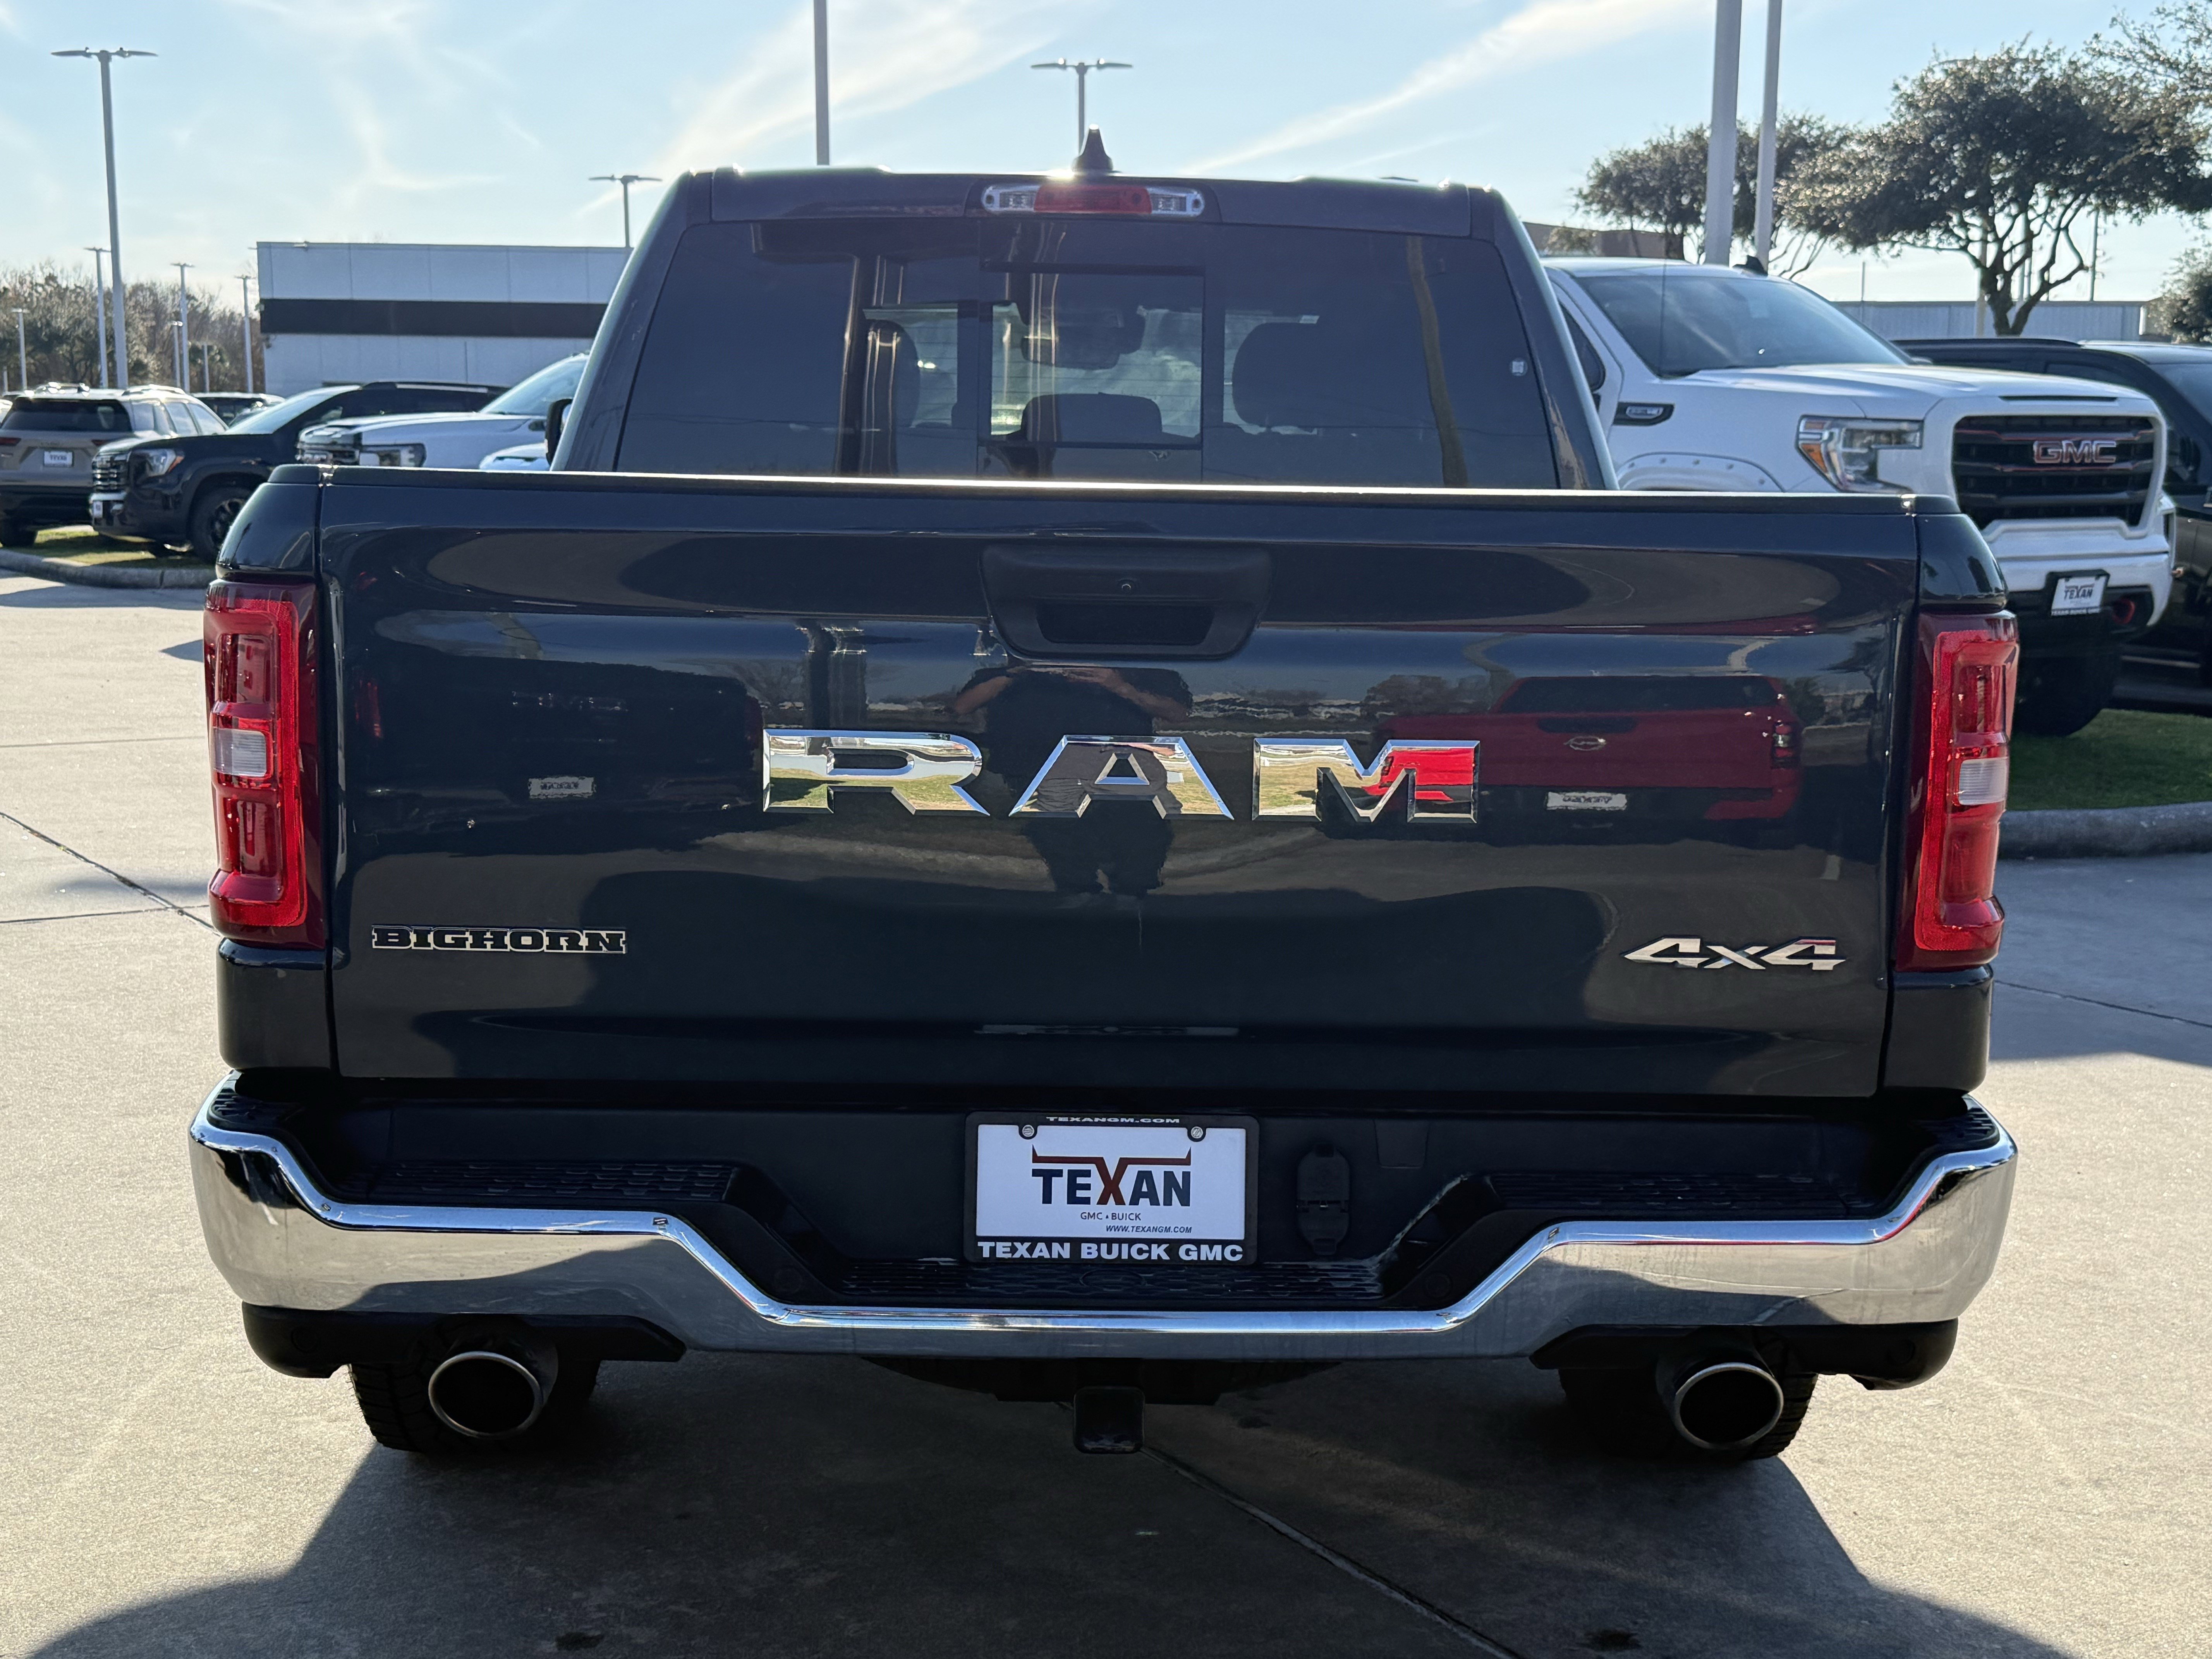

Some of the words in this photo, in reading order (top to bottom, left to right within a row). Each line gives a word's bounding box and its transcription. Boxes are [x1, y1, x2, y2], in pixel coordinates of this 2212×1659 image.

[2033, 440, 2116, 463] GMC
[2064, 586, 2093, 600] TEXAN
[763, 729, 1479, 823] RAM
[372, 925, 626, 954] BIGHORN
[1032, 1156, 1191, 1207] TEXAN
[1111, 1212, 1141, 1221] BUICK
[1106, 1225, 1192, 1233] WWW.TEXANGM.COM
[977, 1241, 1070, 1259] TEXAN
[1081, 1243, 1170, 1260] BUICK
[1178, 1244, 1243, 1261] GMC
